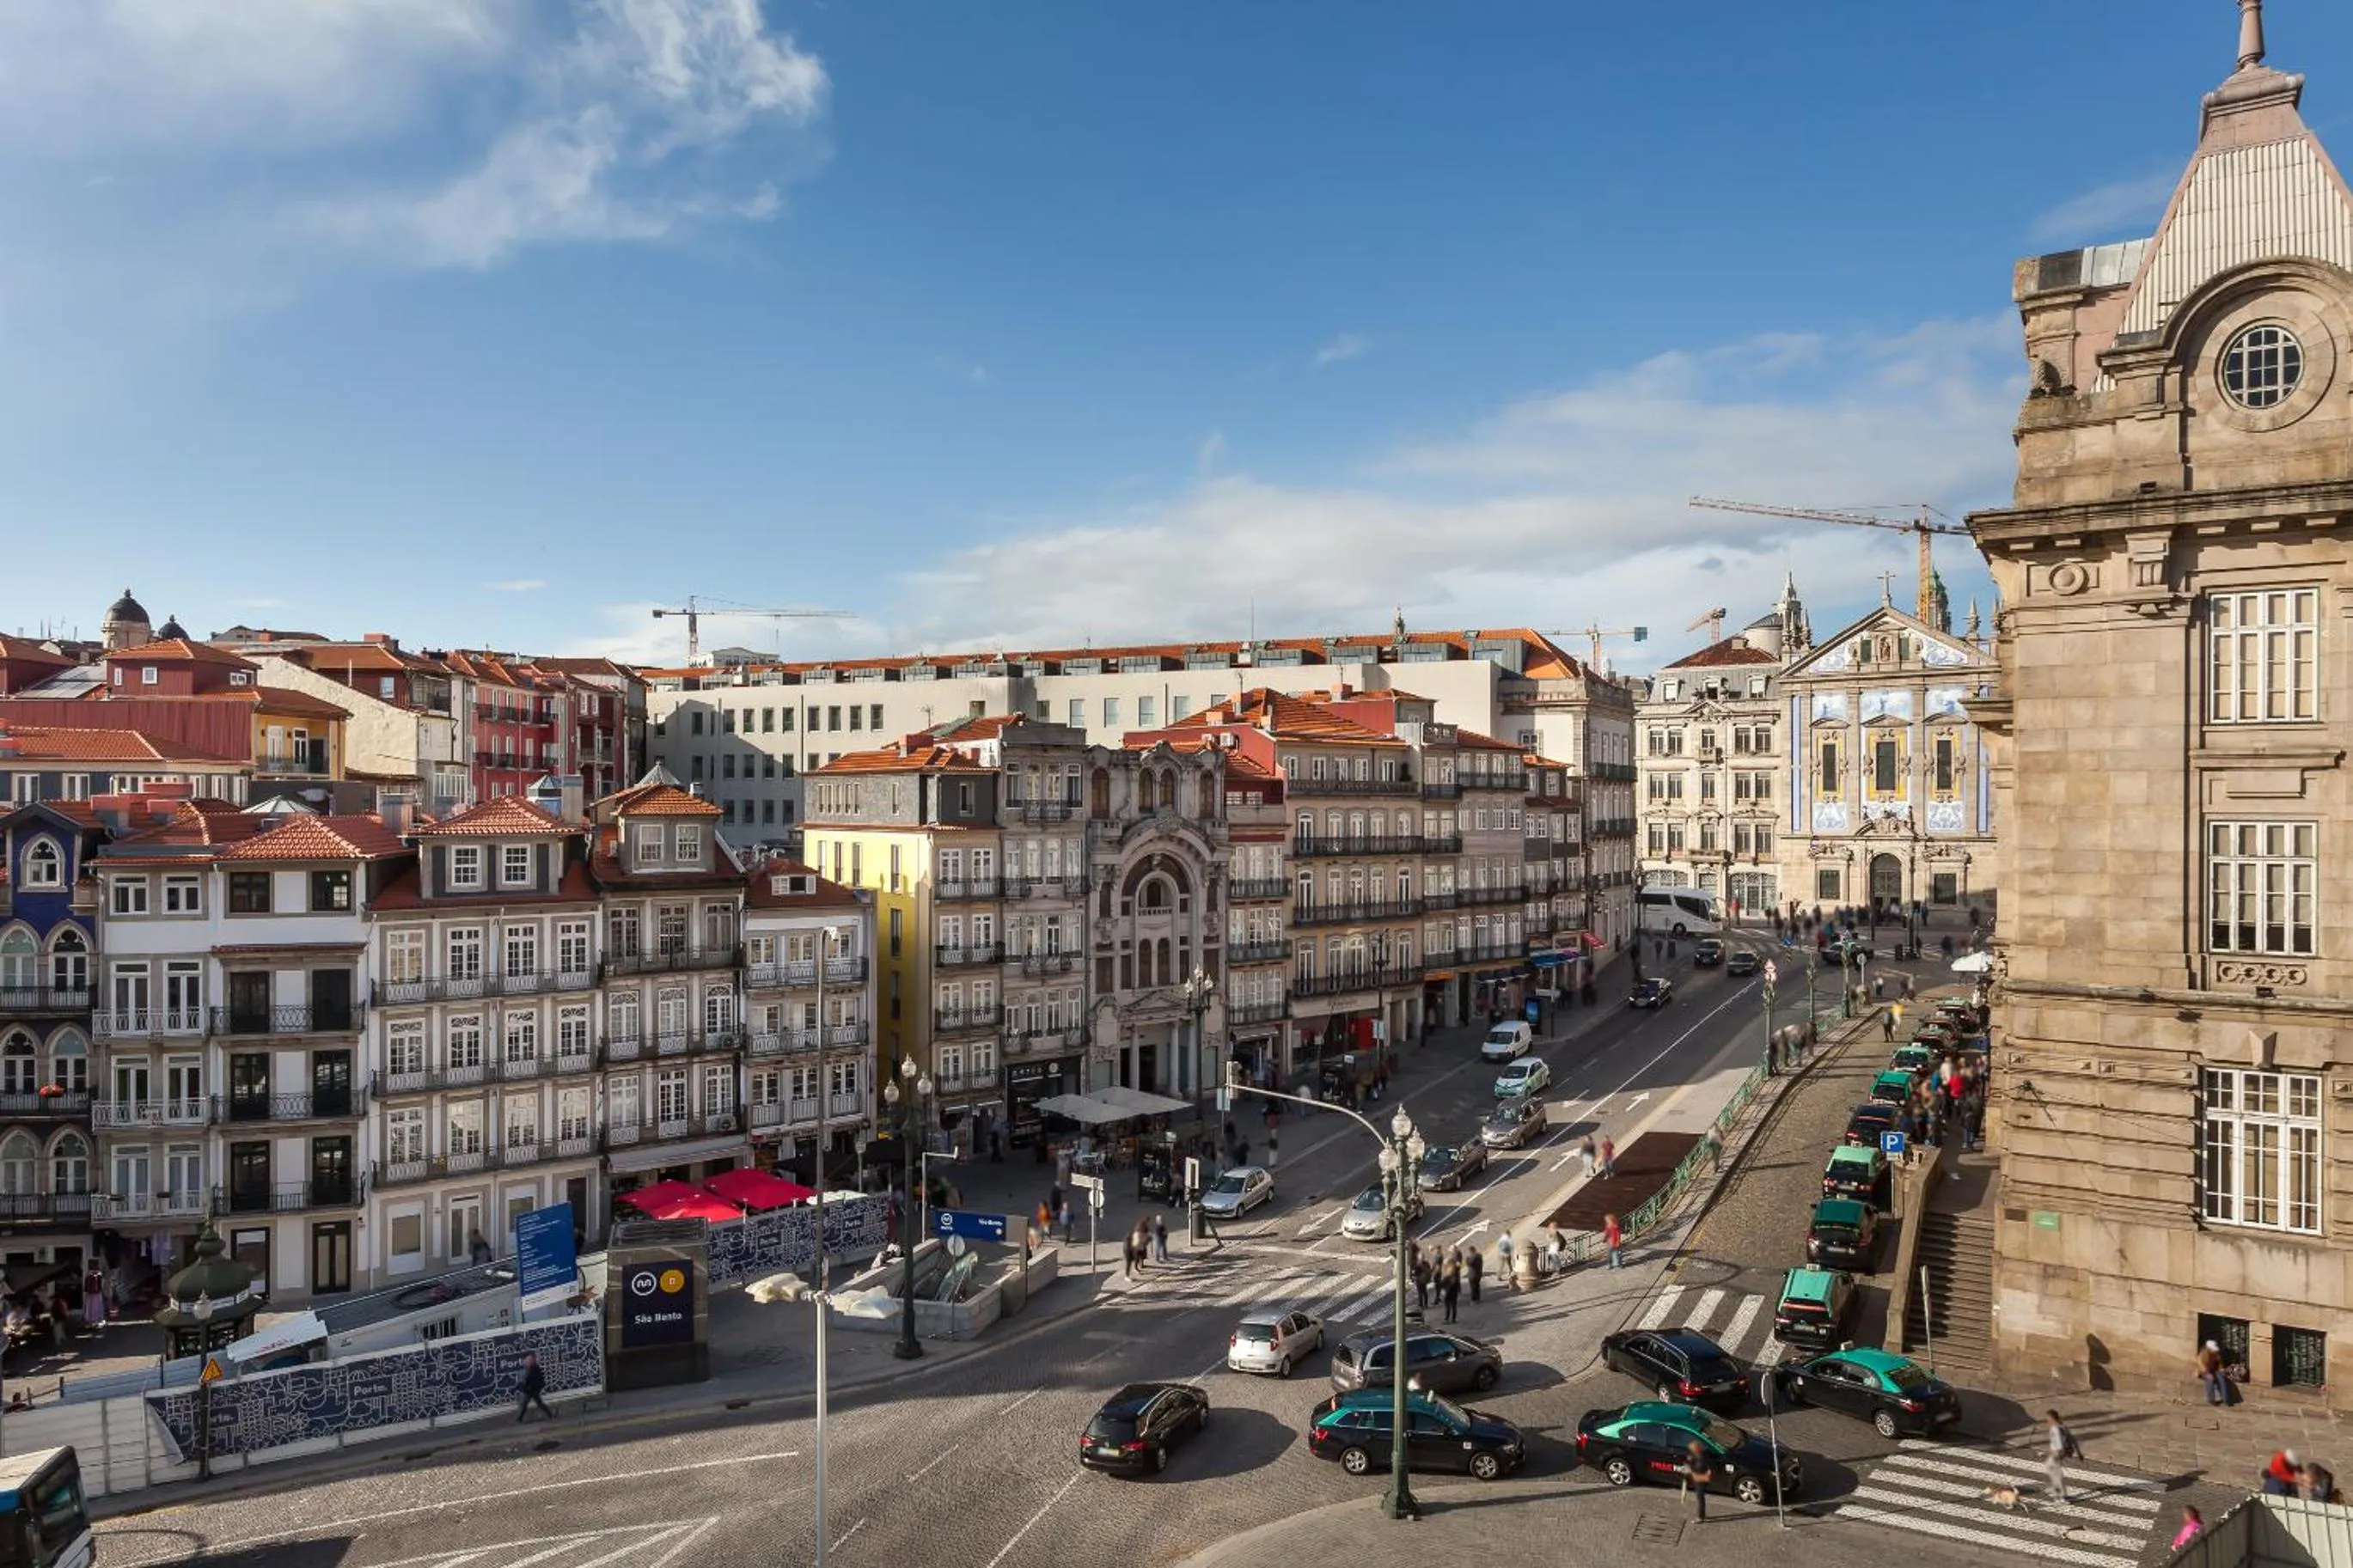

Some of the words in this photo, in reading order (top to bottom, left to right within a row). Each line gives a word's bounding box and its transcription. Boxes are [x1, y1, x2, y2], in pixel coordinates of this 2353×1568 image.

[1886, 1135, 1898, 1150] P
[634, 1315, 651, 1324] São
[654, 1312, 681, 1322] Bento
